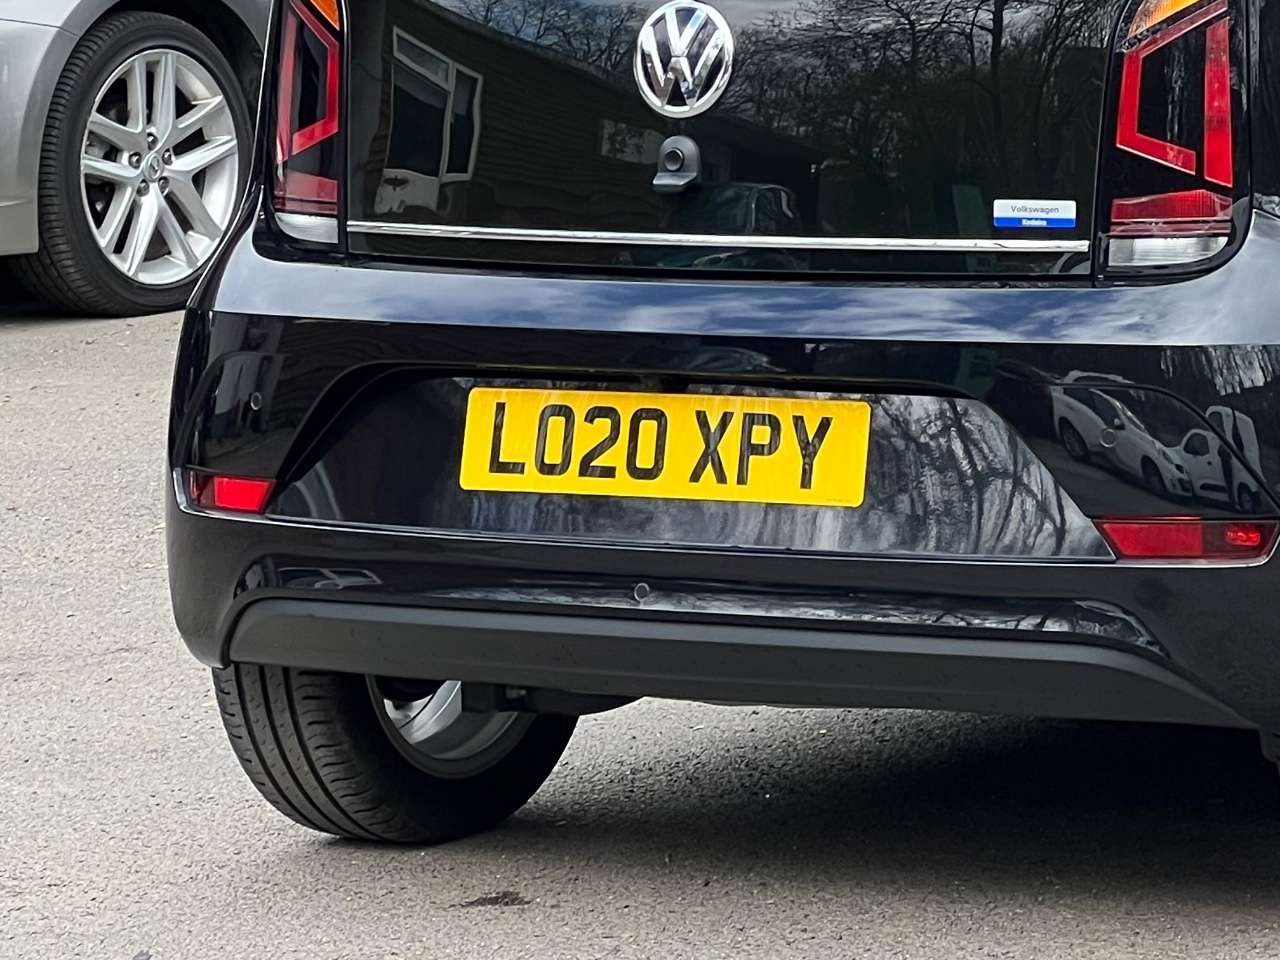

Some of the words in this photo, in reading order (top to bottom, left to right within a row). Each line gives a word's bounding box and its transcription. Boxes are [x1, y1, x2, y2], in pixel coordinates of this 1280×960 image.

[1011, 205, 1059, 214] Volkswagen
[488, 401, 668, 481] LO20
[689, 409, 834, 490] XPY
